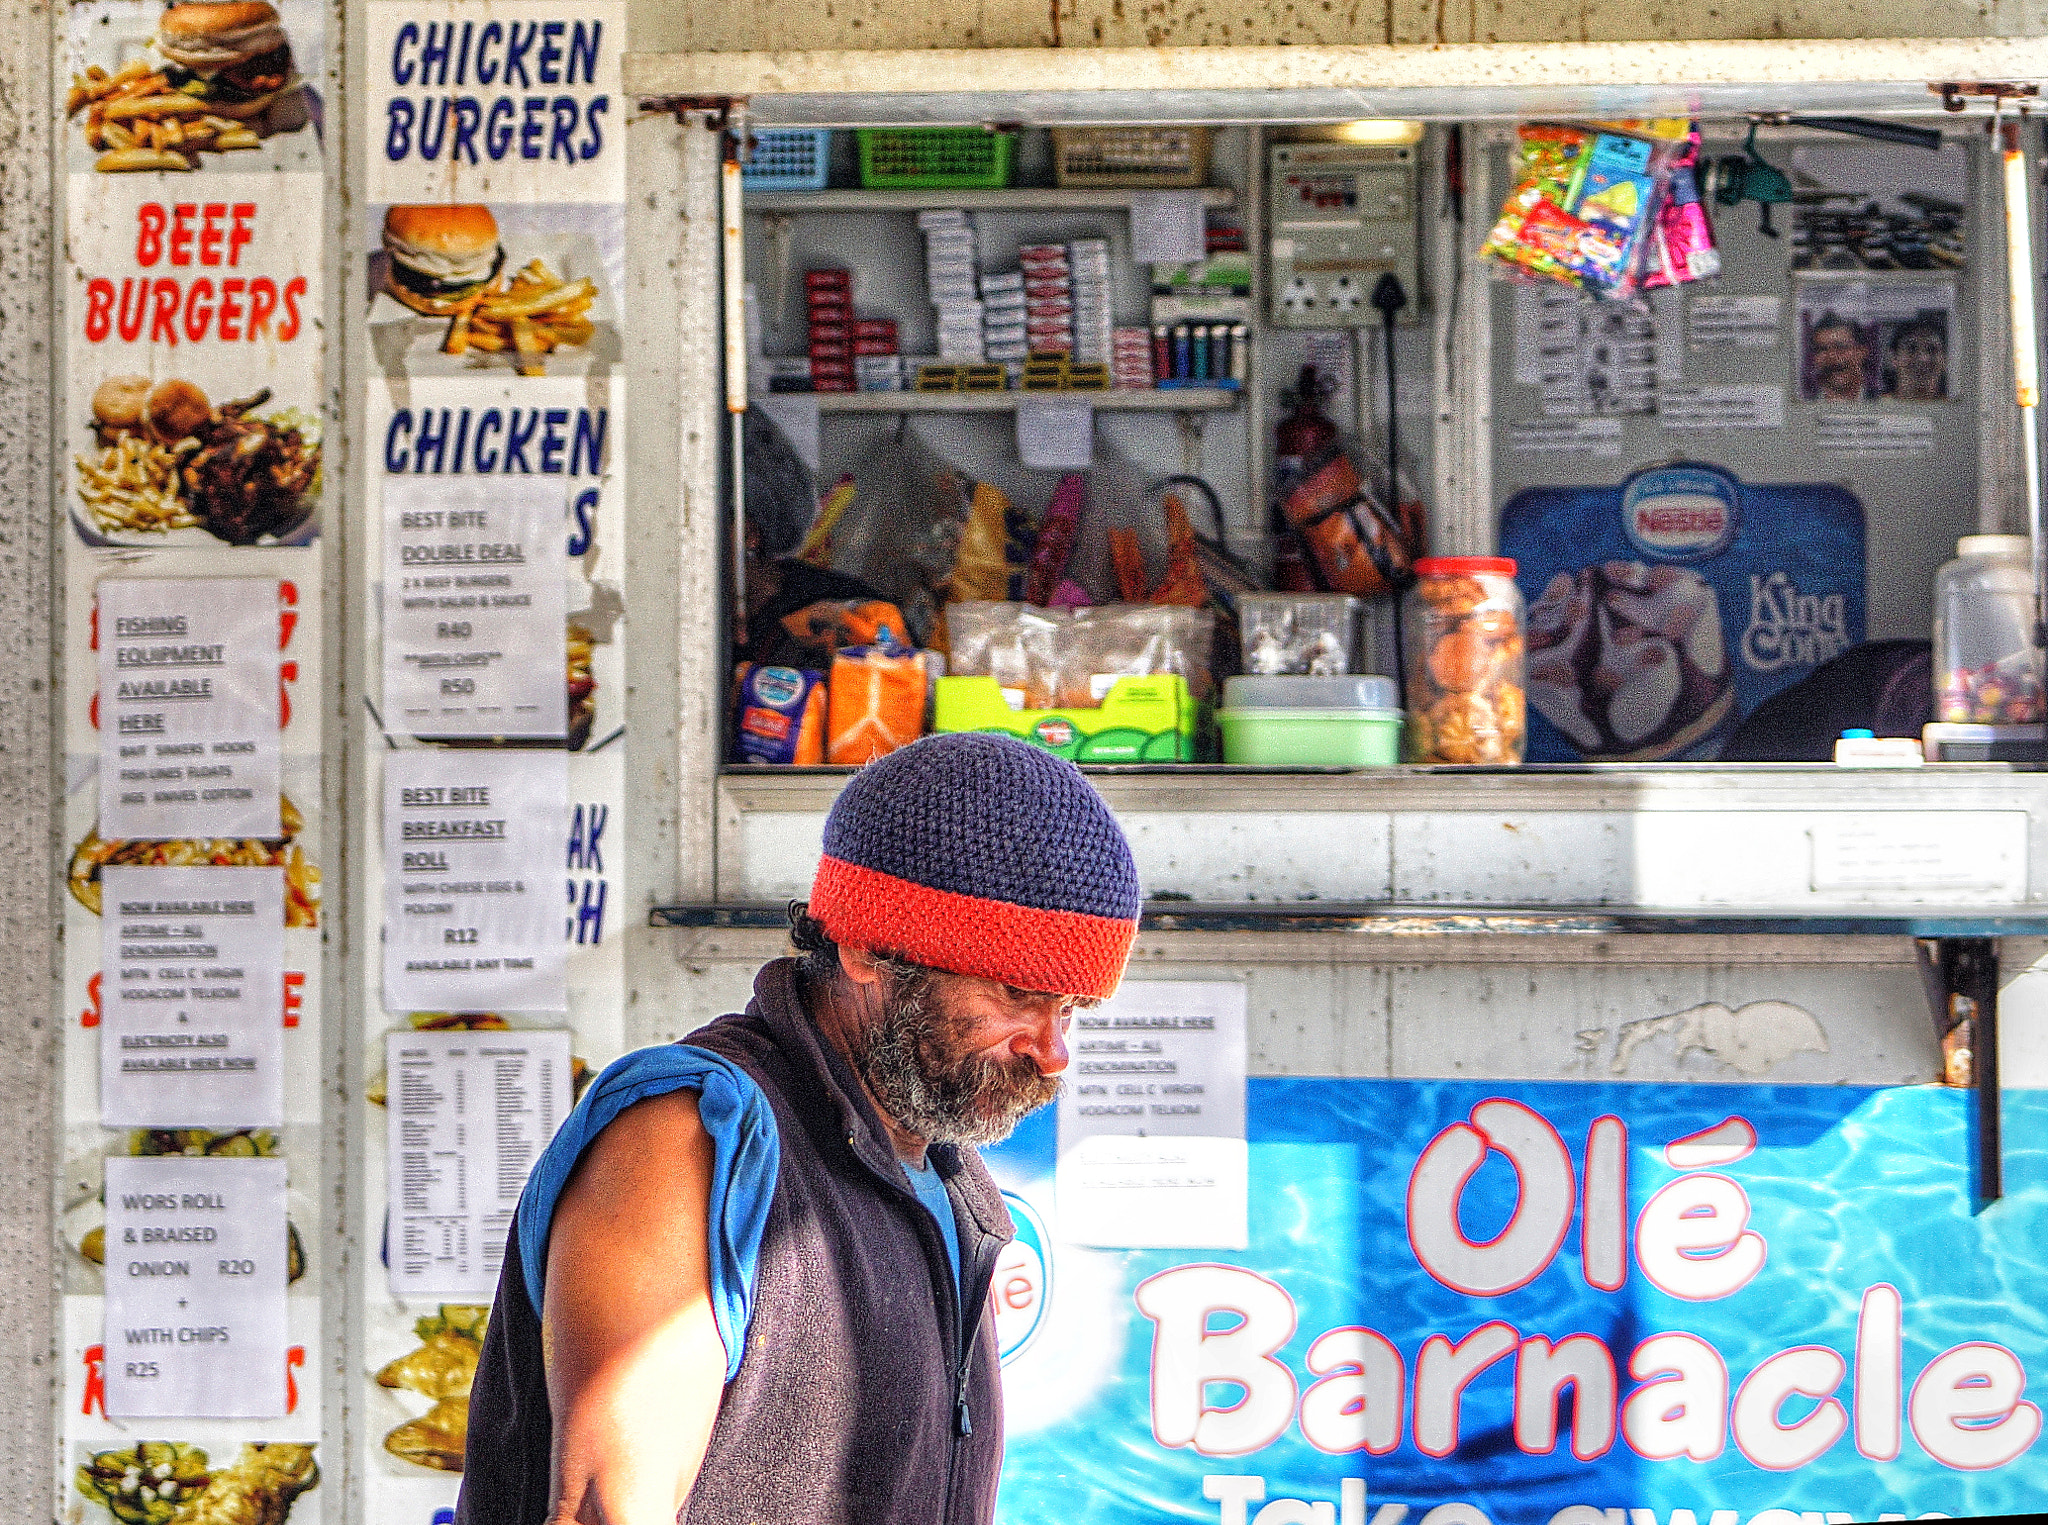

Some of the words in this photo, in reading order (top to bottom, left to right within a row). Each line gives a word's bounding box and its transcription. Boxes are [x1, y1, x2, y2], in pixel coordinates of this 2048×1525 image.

[392, 20, 603, 89] CHICKEN
[384, 95, 609, 166] BURGERS
[135, 202, 257, 268] BEEF
[85, 277, 308, 347] BURGERS
[385, 407, 608, 475] CHICKEN
[401, 511, 443, 529] BEST
[450, 510, 487, 528] BITE
[403, 544, 474, 561] DOUBLE
[479, 543, 524, 560] DEAL
[1750, 571, 1845, 634] King
[116, 616, 187, 632] FISHING
[117, 645, 225, 663] EQUIPMENT
[117, 678, 211, 696] AVAILABLE
[119, 713, 165, 730] HERE
[402, 787, 445, 803] BEST
[451, 787, 489, 802] BITE
[402, 820, 506, 836] BREAKFAST
[403, 852, 448, 868] ROLL
[444, 928, 478, 945] R12
[406, 959, 471, 971] AVAILABLE
[1078, 1017, 1109, 1028] NOW
[1114, 1016, 1179, 1027] AVAILABLE
[1183, 1016, 1215, 1027] HERE
[1078, 1105, 1144, 1116] VODACOM
[121, 1193, 178, 1210] WORS
[182, 1193, 226, 1210] ROLL
[1405, 1095, 1768, 1303] Olé
[124, 1228, 136, 1243] &
[142, 1226, 218, 1243] BRAISED
[128, 1259, 190, 1277] ONION
[218, 1259, 255, 1275] R20
[125, 1328, 173, 1344] WITH
[178, 1326, 230, 1343] CHIPS
[125, 1362, 159, 1378] R25
[1133, 1261, 2042, 1471] Barnacle
